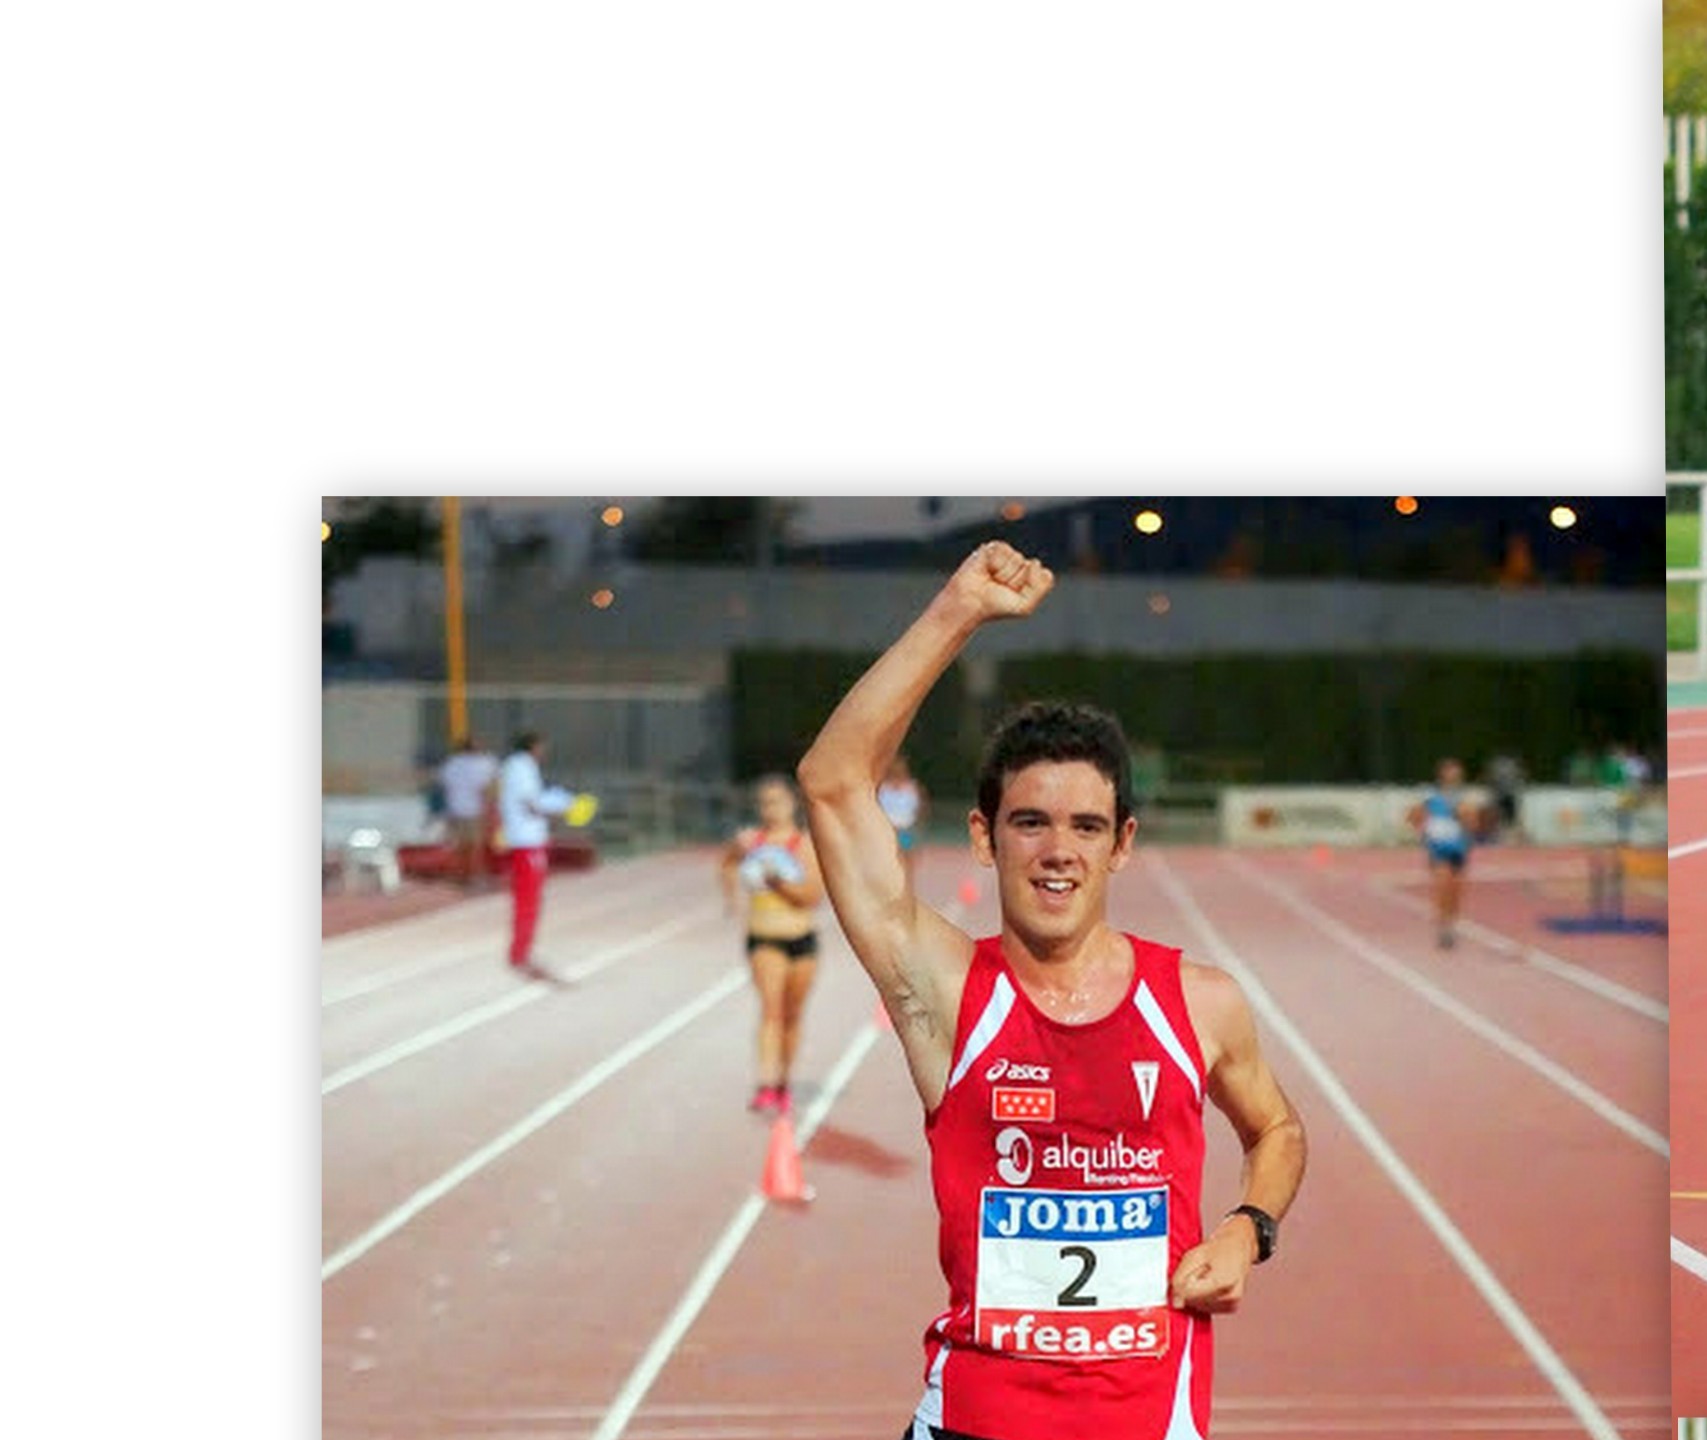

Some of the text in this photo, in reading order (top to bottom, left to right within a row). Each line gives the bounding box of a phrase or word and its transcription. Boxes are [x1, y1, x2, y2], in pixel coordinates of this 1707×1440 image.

[1042, 1132, 1164, 1183] alquiber
[1057, 1245, 1098, 1307] 2
[990, 1315, 1157, 1353] rfea.es
